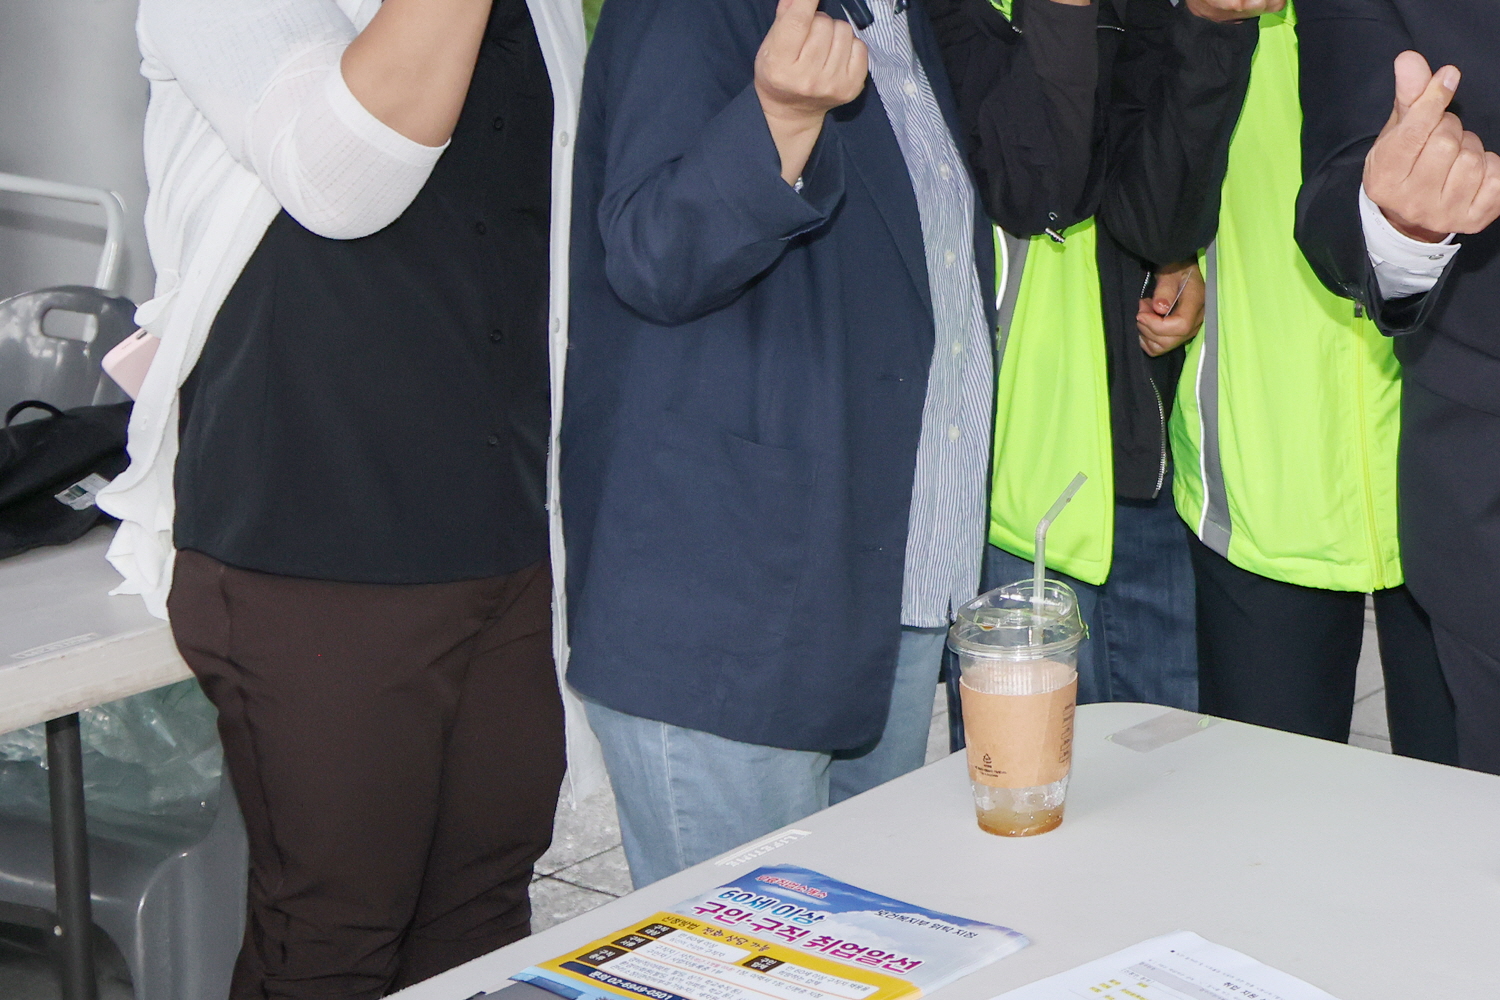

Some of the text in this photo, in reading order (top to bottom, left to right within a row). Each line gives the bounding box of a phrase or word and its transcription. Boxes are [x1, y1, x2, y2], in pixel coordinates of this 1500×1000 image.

[756, 873, 829, 899] 무료직업소개소
[719, 890, 826, 924] 60세 이상
[878, 908, 978, 938] 보건복지부 위탁 지정
[662, 916, 770, 952] 신청방법 전화 상담 가능
[696, 902, 921, 973] 구인·구직 취업알선
[608, 977, 673, 1000] 02-6949-0501
